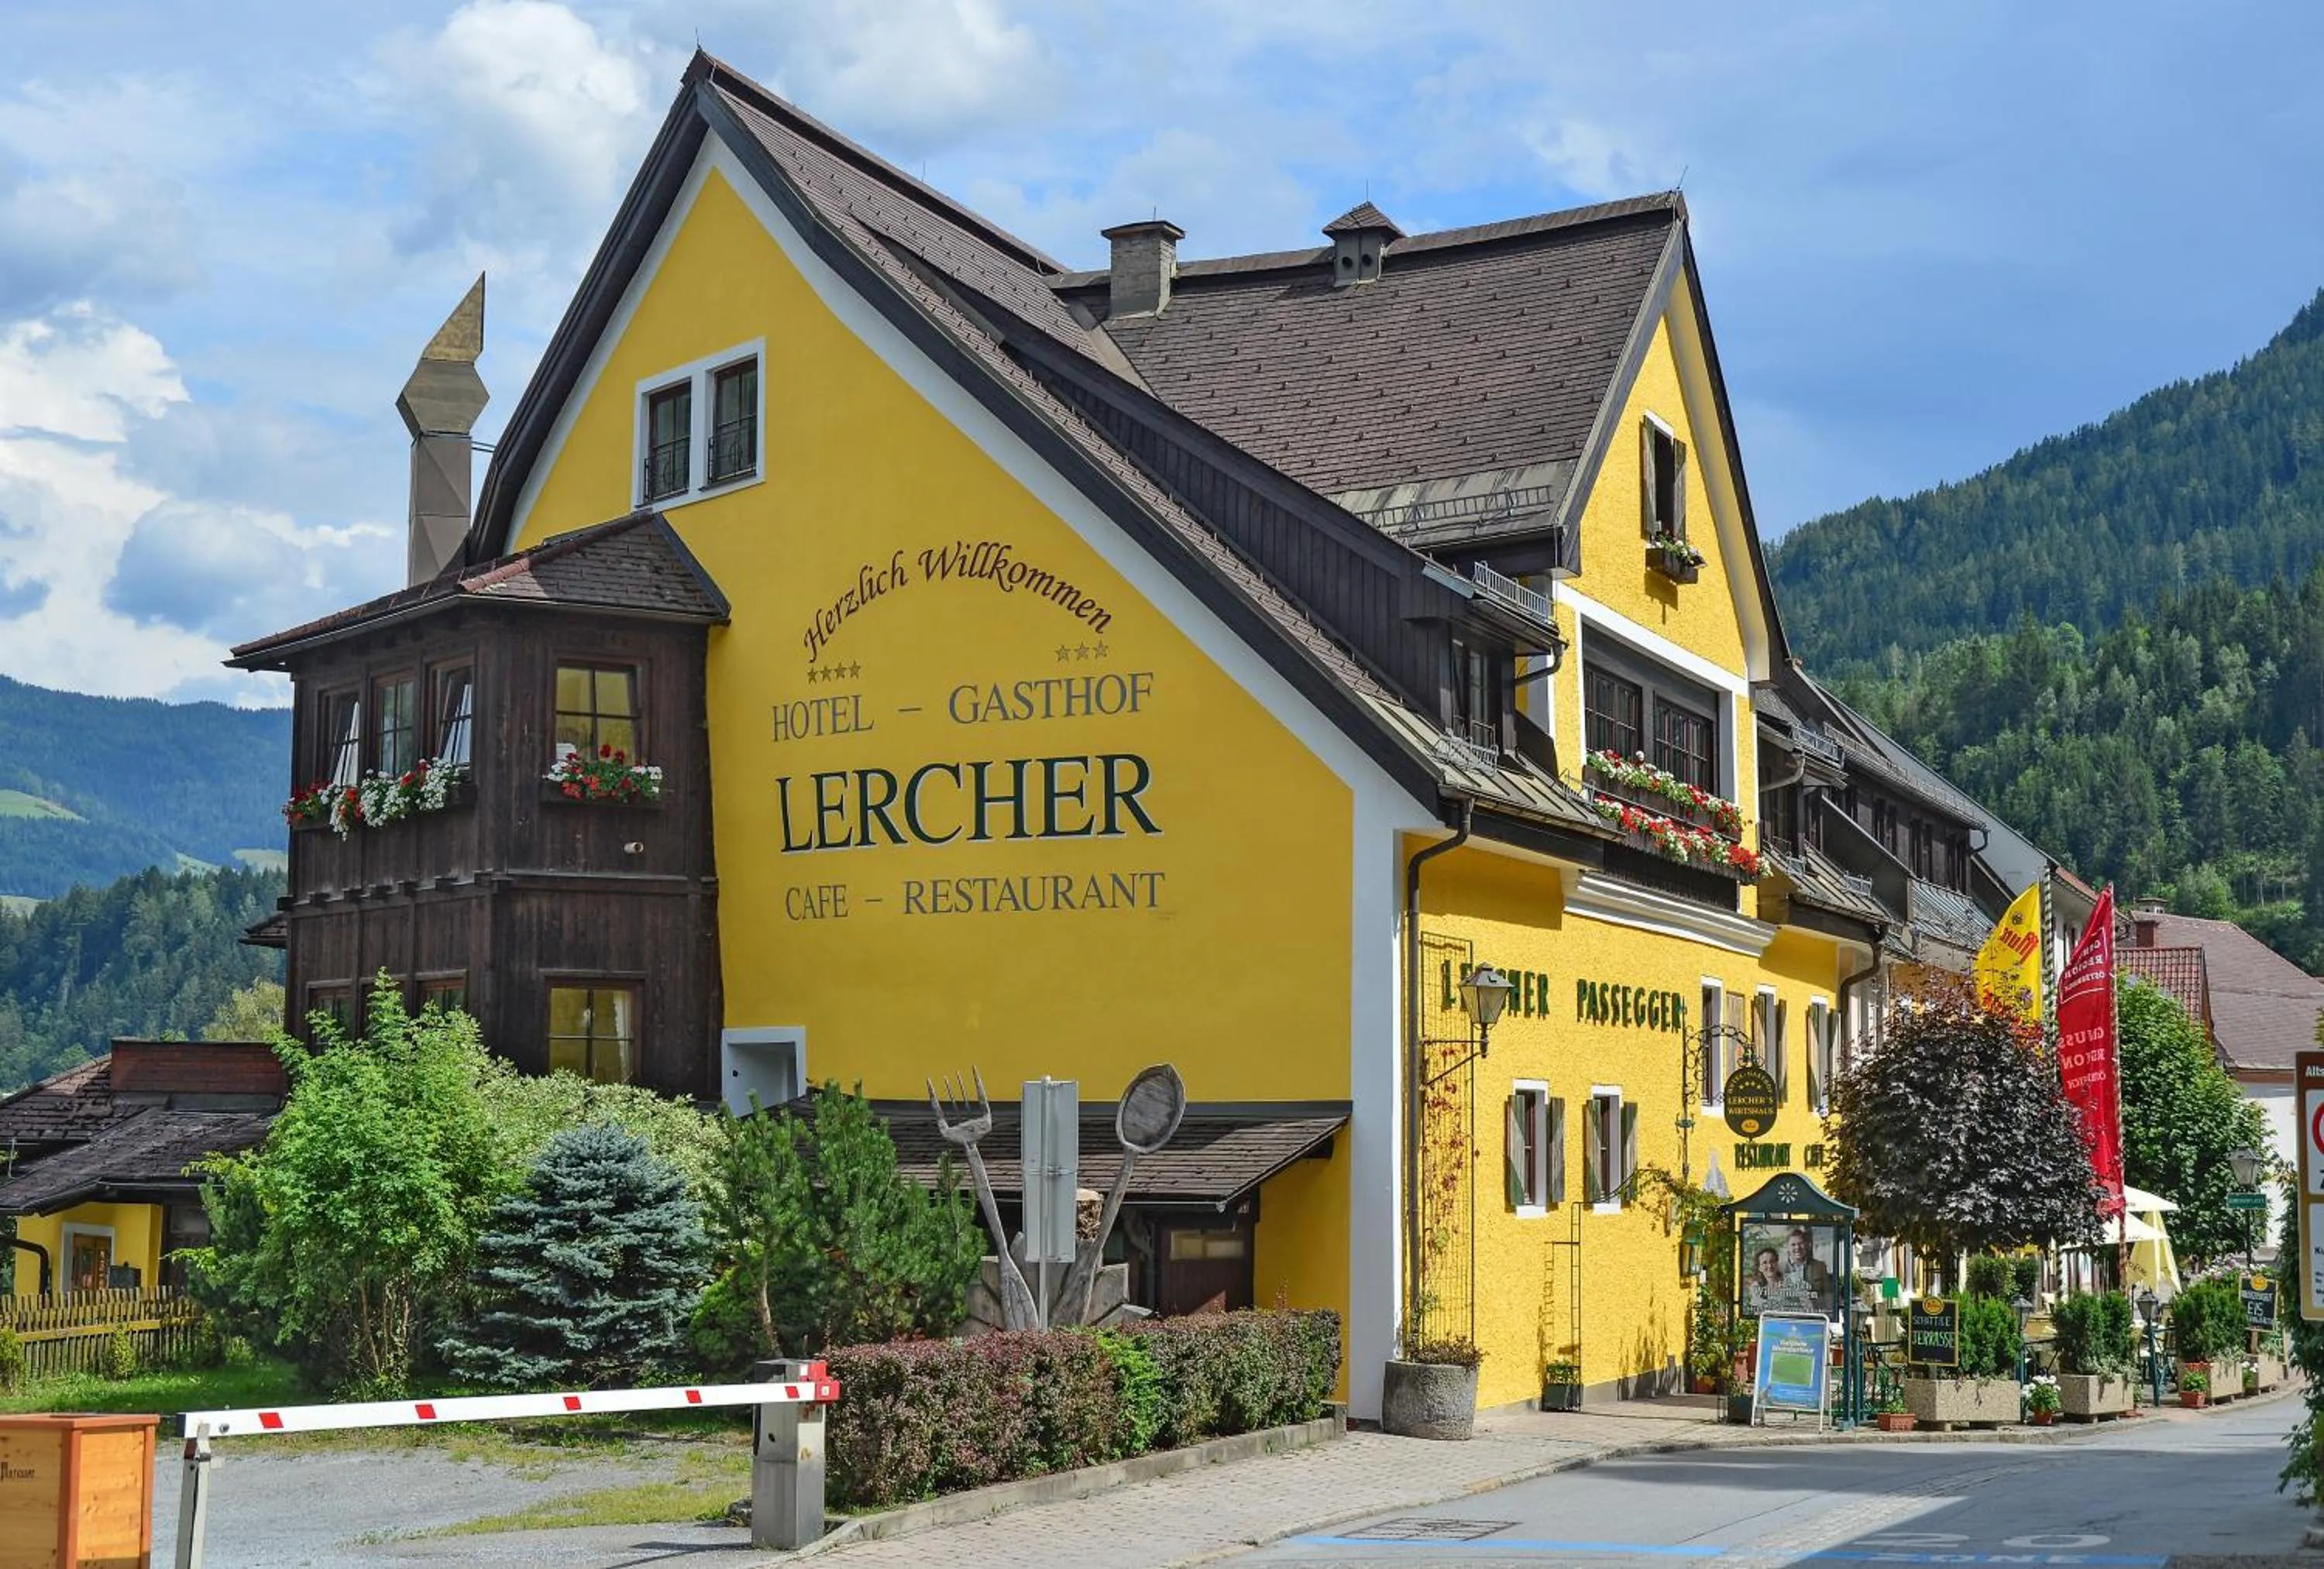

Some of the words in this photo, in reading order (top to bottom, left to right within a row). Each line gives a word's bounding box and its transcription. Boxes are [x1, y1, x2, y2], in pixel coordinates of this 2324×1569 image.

[803, 550, 908, 663] Herzlich
[918, 541, 1112, 633] Willkommen
[772, 695, 875, 742] HOTEL
[948, 672, 1153, 723] GASTHOF
[775, 754, 1162, 853] LERCHER
[785, 884, 848, 921] CAFE
[903, 872, 1165, 915] RESTAURANT
[1576, 978, 1683, 1033] PASSEGGER
[1728, 1107, 1773, 1115] WIRTSHAUS
[1854, 1532, 2110, 1548] 20
[1868, 1552, 2089, 1564] ZONE
